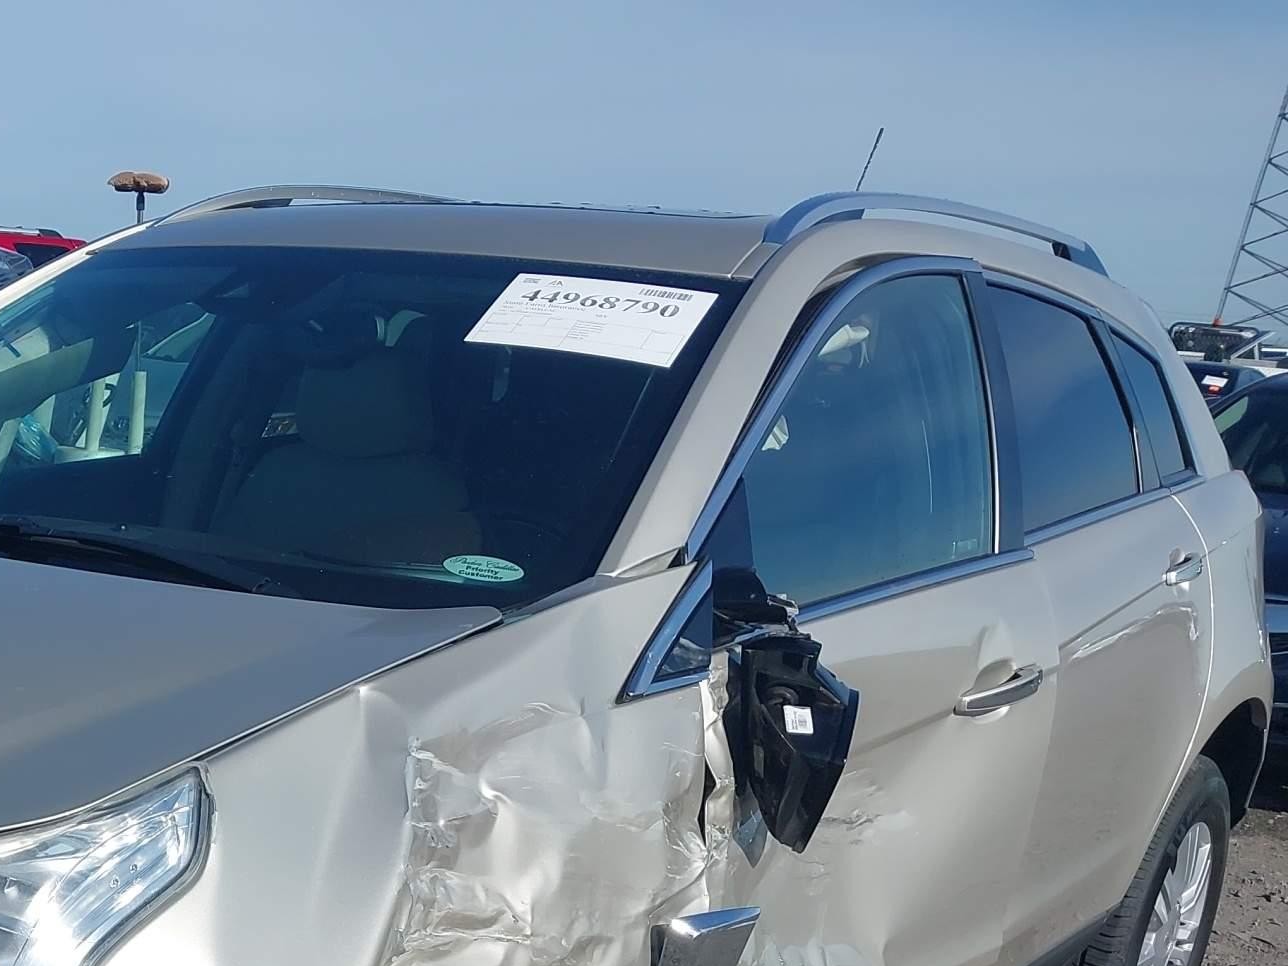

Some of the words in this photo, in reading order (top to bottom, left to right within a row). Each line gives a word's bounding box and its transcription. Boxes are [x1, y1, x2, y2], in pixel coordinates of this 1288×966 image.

[520, 288, 680, 319] 44968790
[458, 569, 504, 581] Customer
[465, 565, 499, 576] Priority
